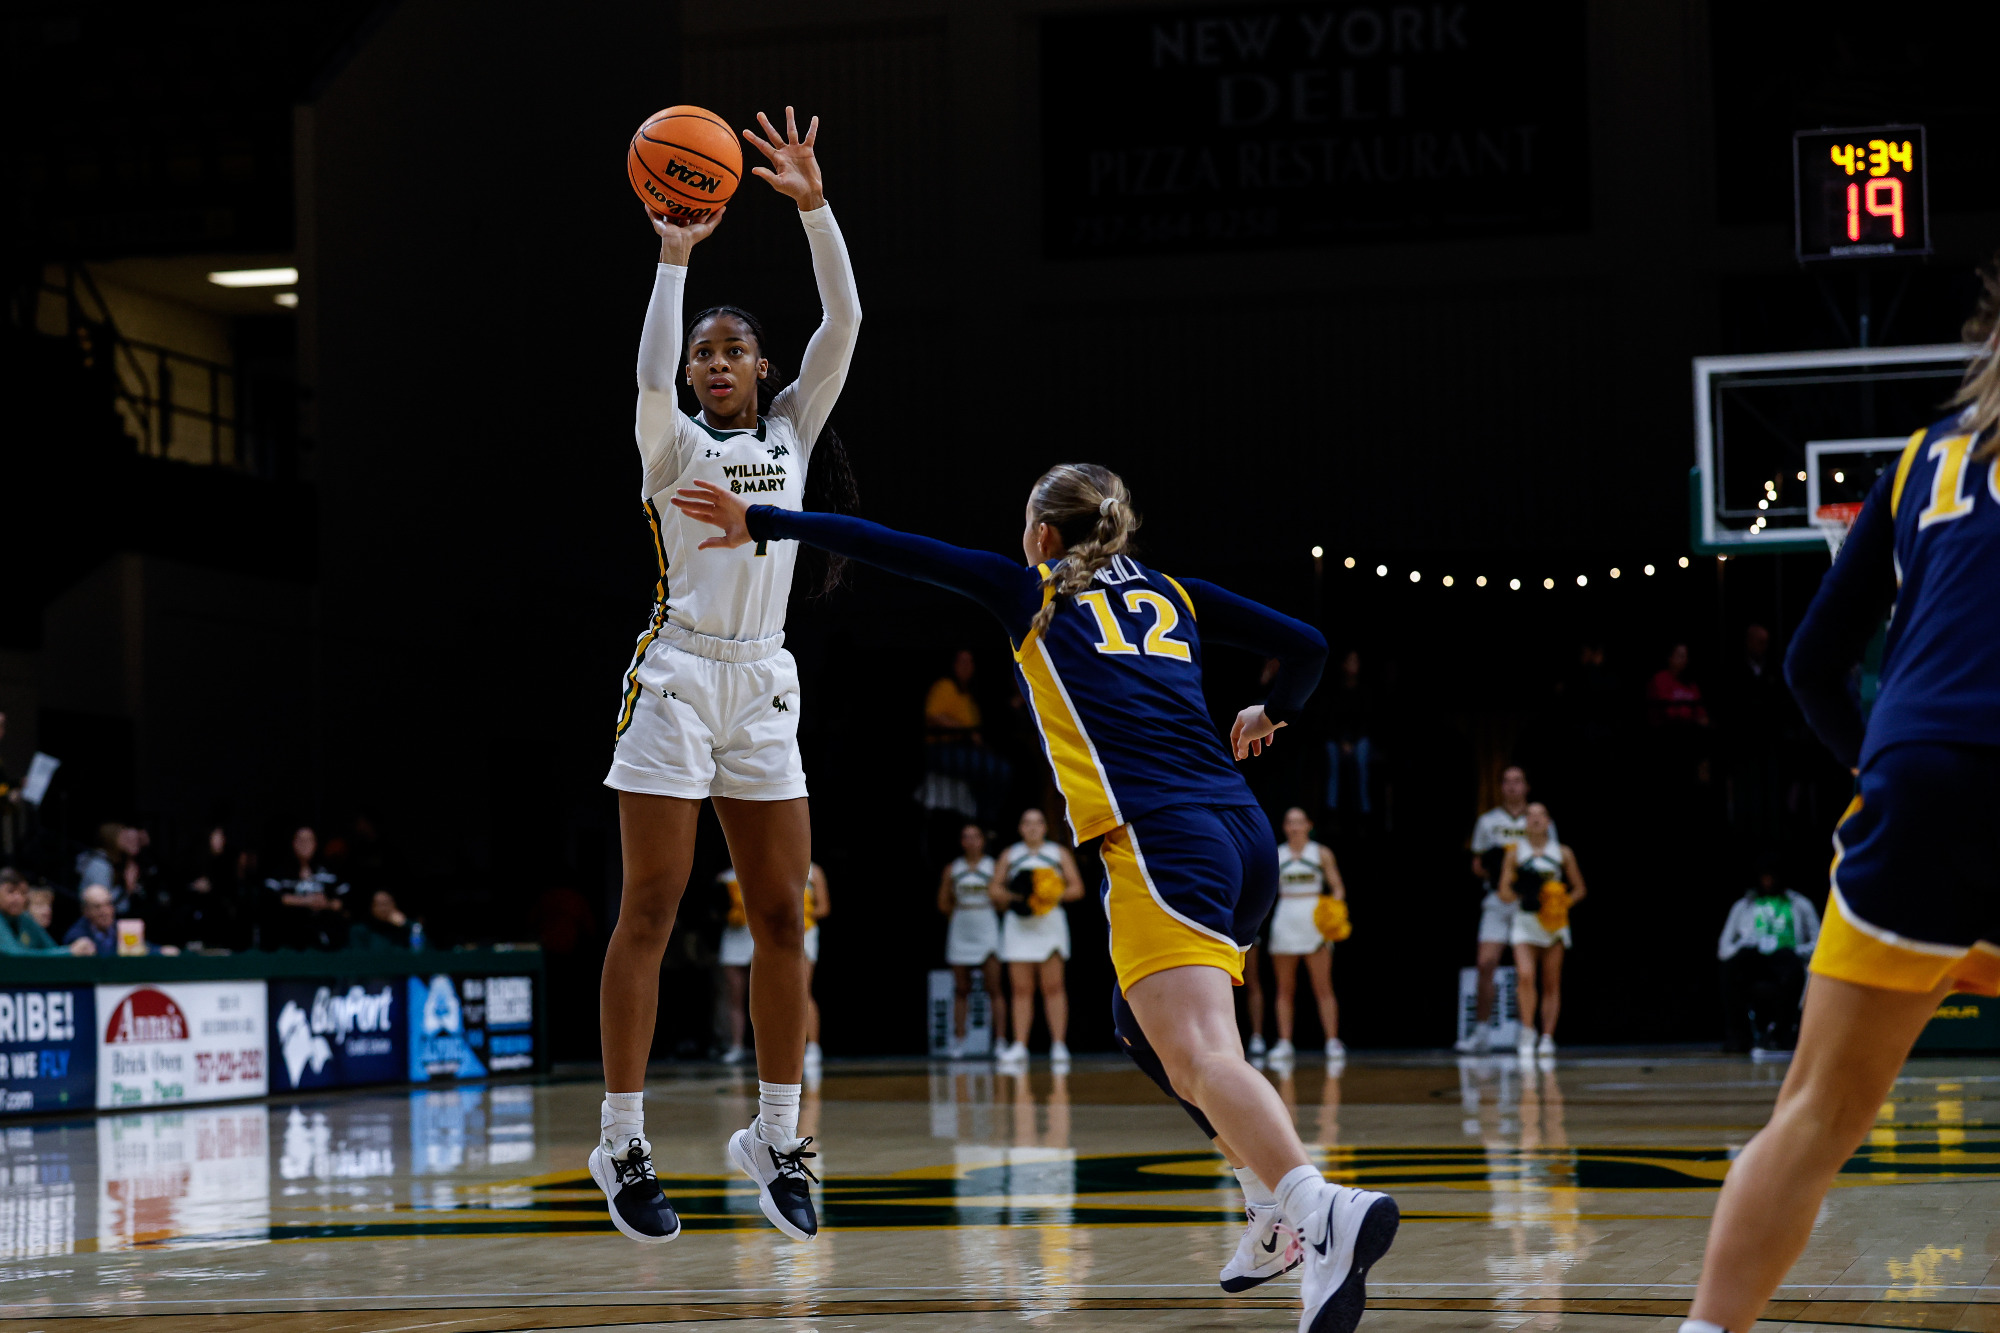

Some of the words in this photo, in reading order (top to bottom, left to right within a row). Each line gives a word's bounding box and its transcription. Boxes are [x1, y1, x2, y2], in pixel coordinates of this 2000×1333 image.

[1149, 13, 1281, 70] NEW
[1297, 1, 1473, 62] YORK
[1215, 63, 1408, 130] DELI
[665, 159, 722, 194] NCAA
[1087, 145, 1222, 197] PIZZA
[1236, 123, 1543, 190] RESTAURANT
[1831, 139, 1913, 177] 4:34
[644, 179, 711, 218] Wilson
[1847, 177, 1905, 241] 19
[722, 463, 787, 478] WILLIAM
[743, 478, 786, 493] MARY
[1918, 430, 2000, 532] 1
[1074, 588, 1192, 663] 12
